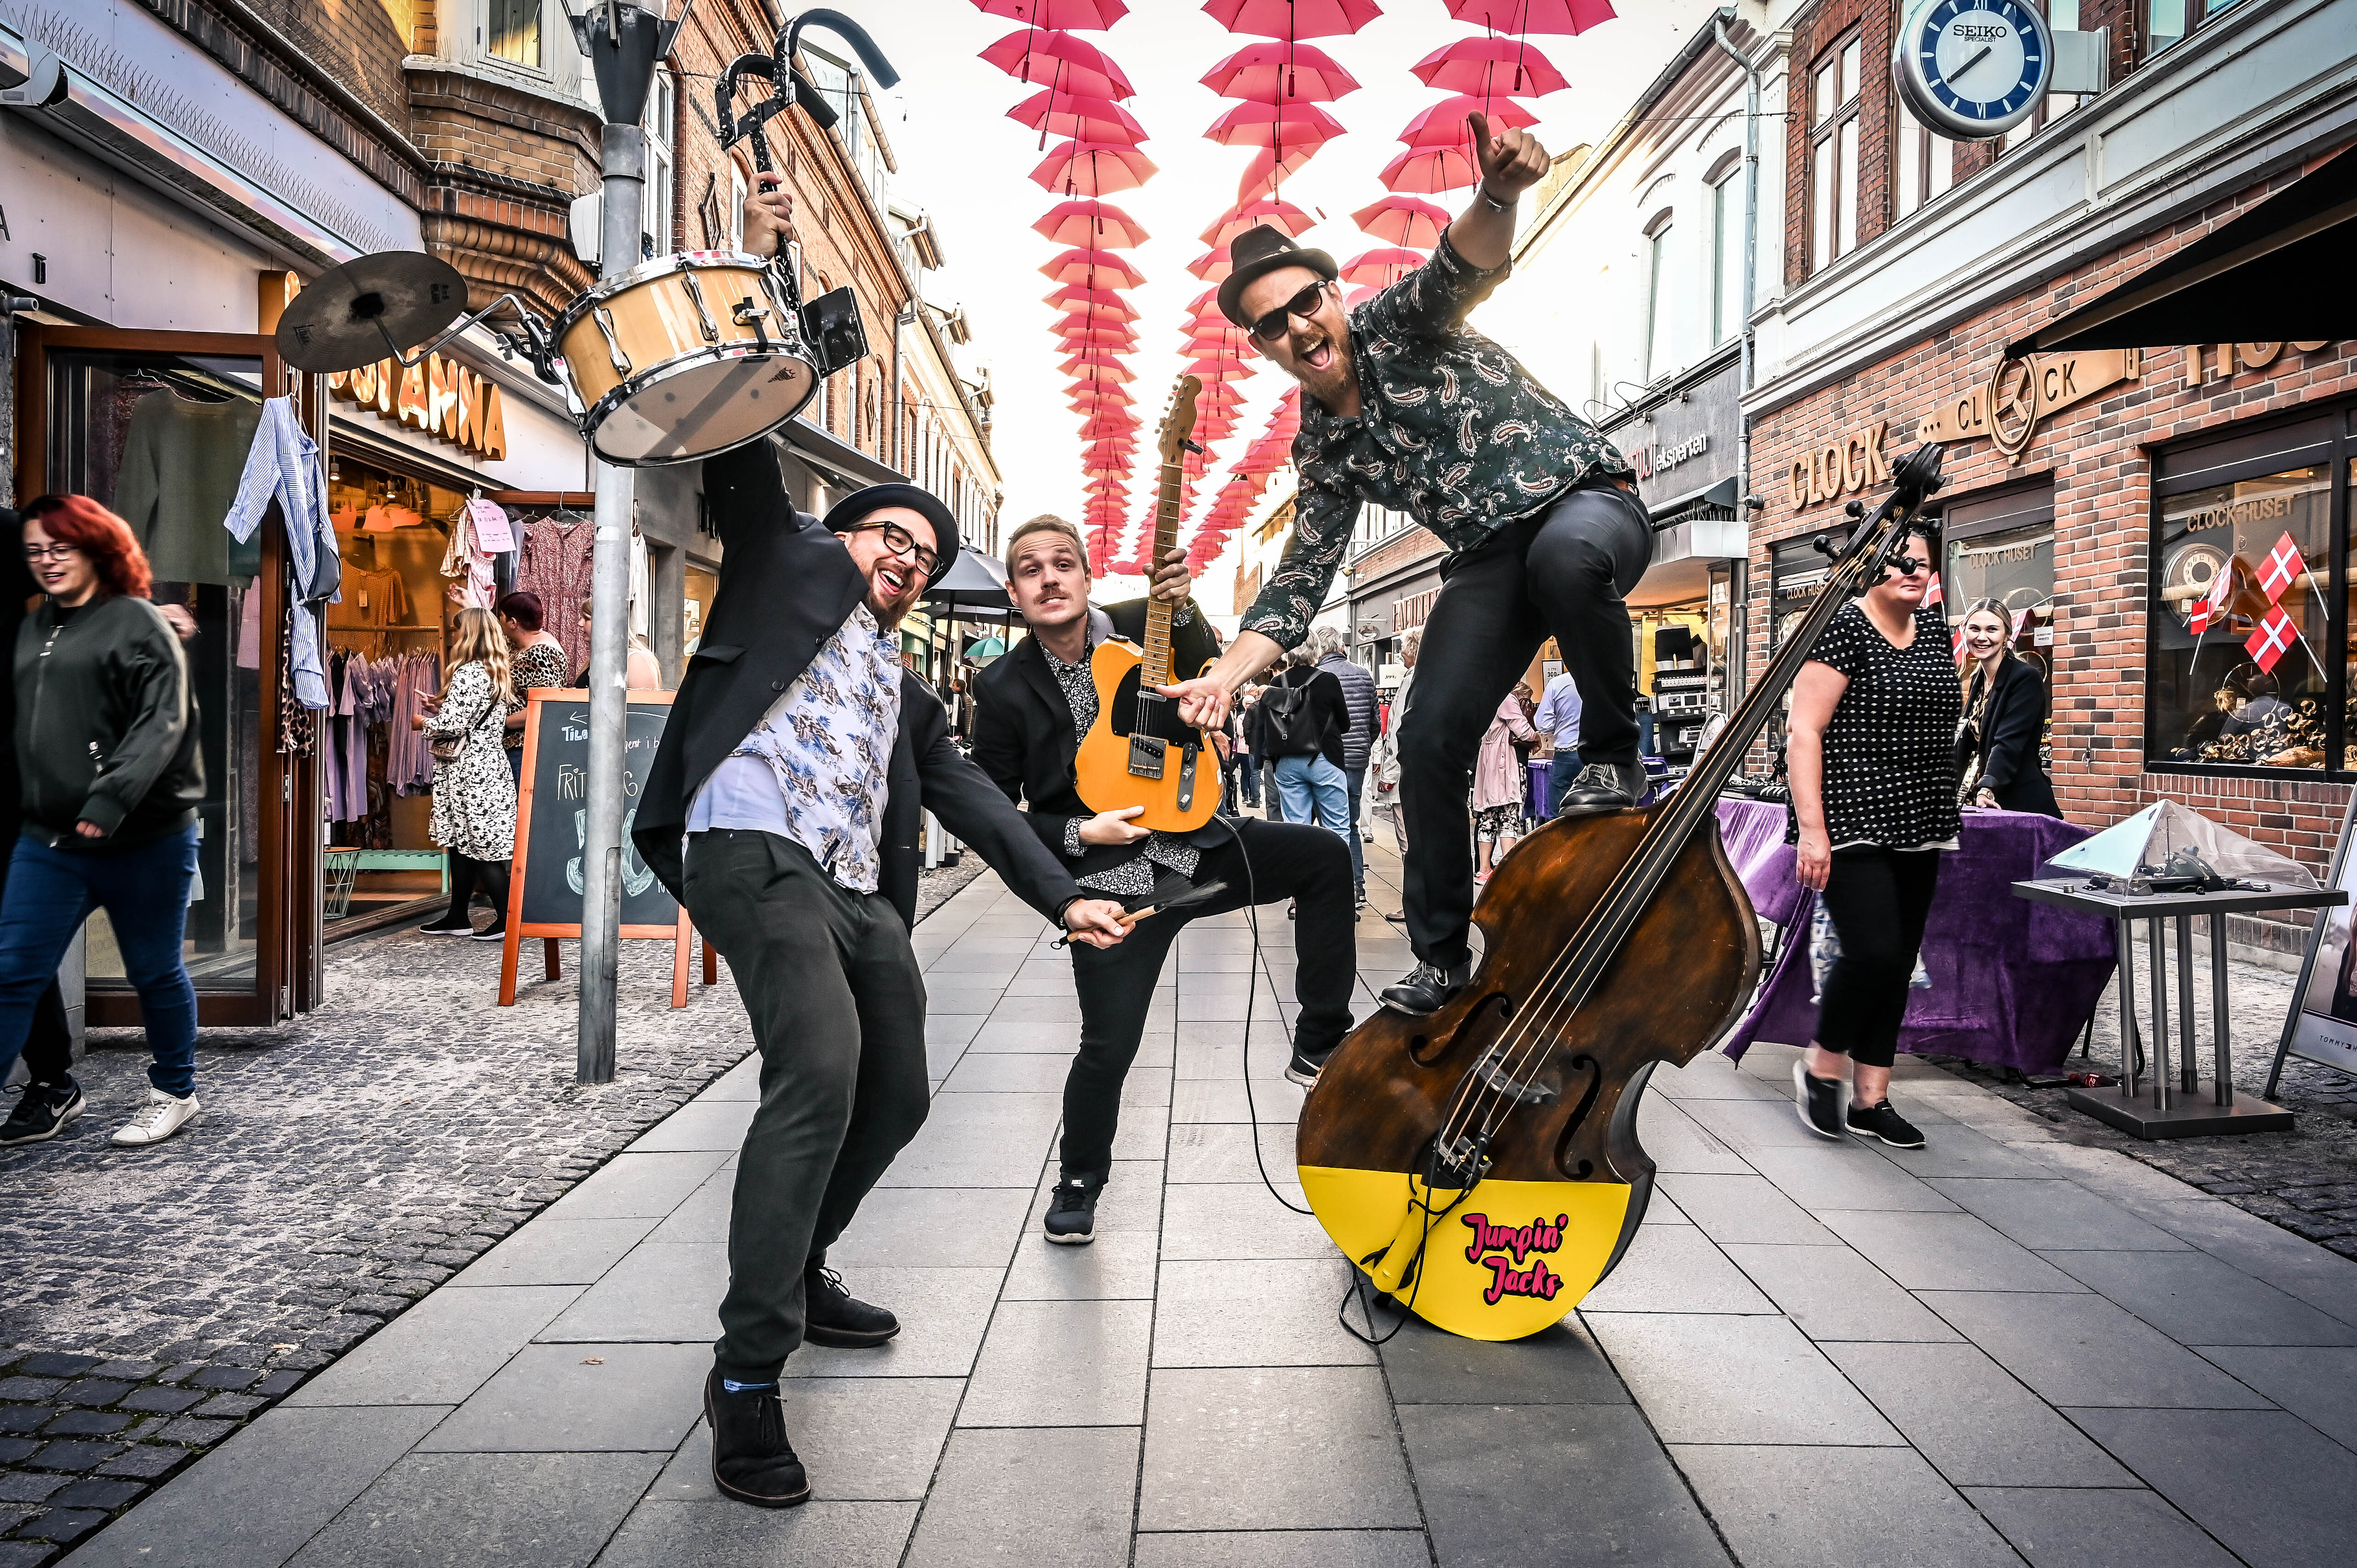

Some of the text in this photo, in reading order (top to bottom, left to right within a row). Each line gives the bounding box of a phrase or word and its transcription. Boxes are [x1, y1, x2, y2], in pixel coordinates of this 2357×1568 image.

[1953, 24, 2007, 38] SEIKO
[1976, 103, 1986, 119] VI
[1656, 433, 1706, 471] eksperten
[1789, 420, 1889, 509] CLOCK
[2187, 495, 2294, 532] CLOCK HUSET
[1969, 543, 2036, 569] CLOCK HUSET
[1787, 585, 1806, 600] CLOCK
[2320, 1035, 2345, 1047] TOMMY
[1463, 1213, 1568, 1263] Jumpin'
[1484, 1257, 1563, 1304] Jacks
